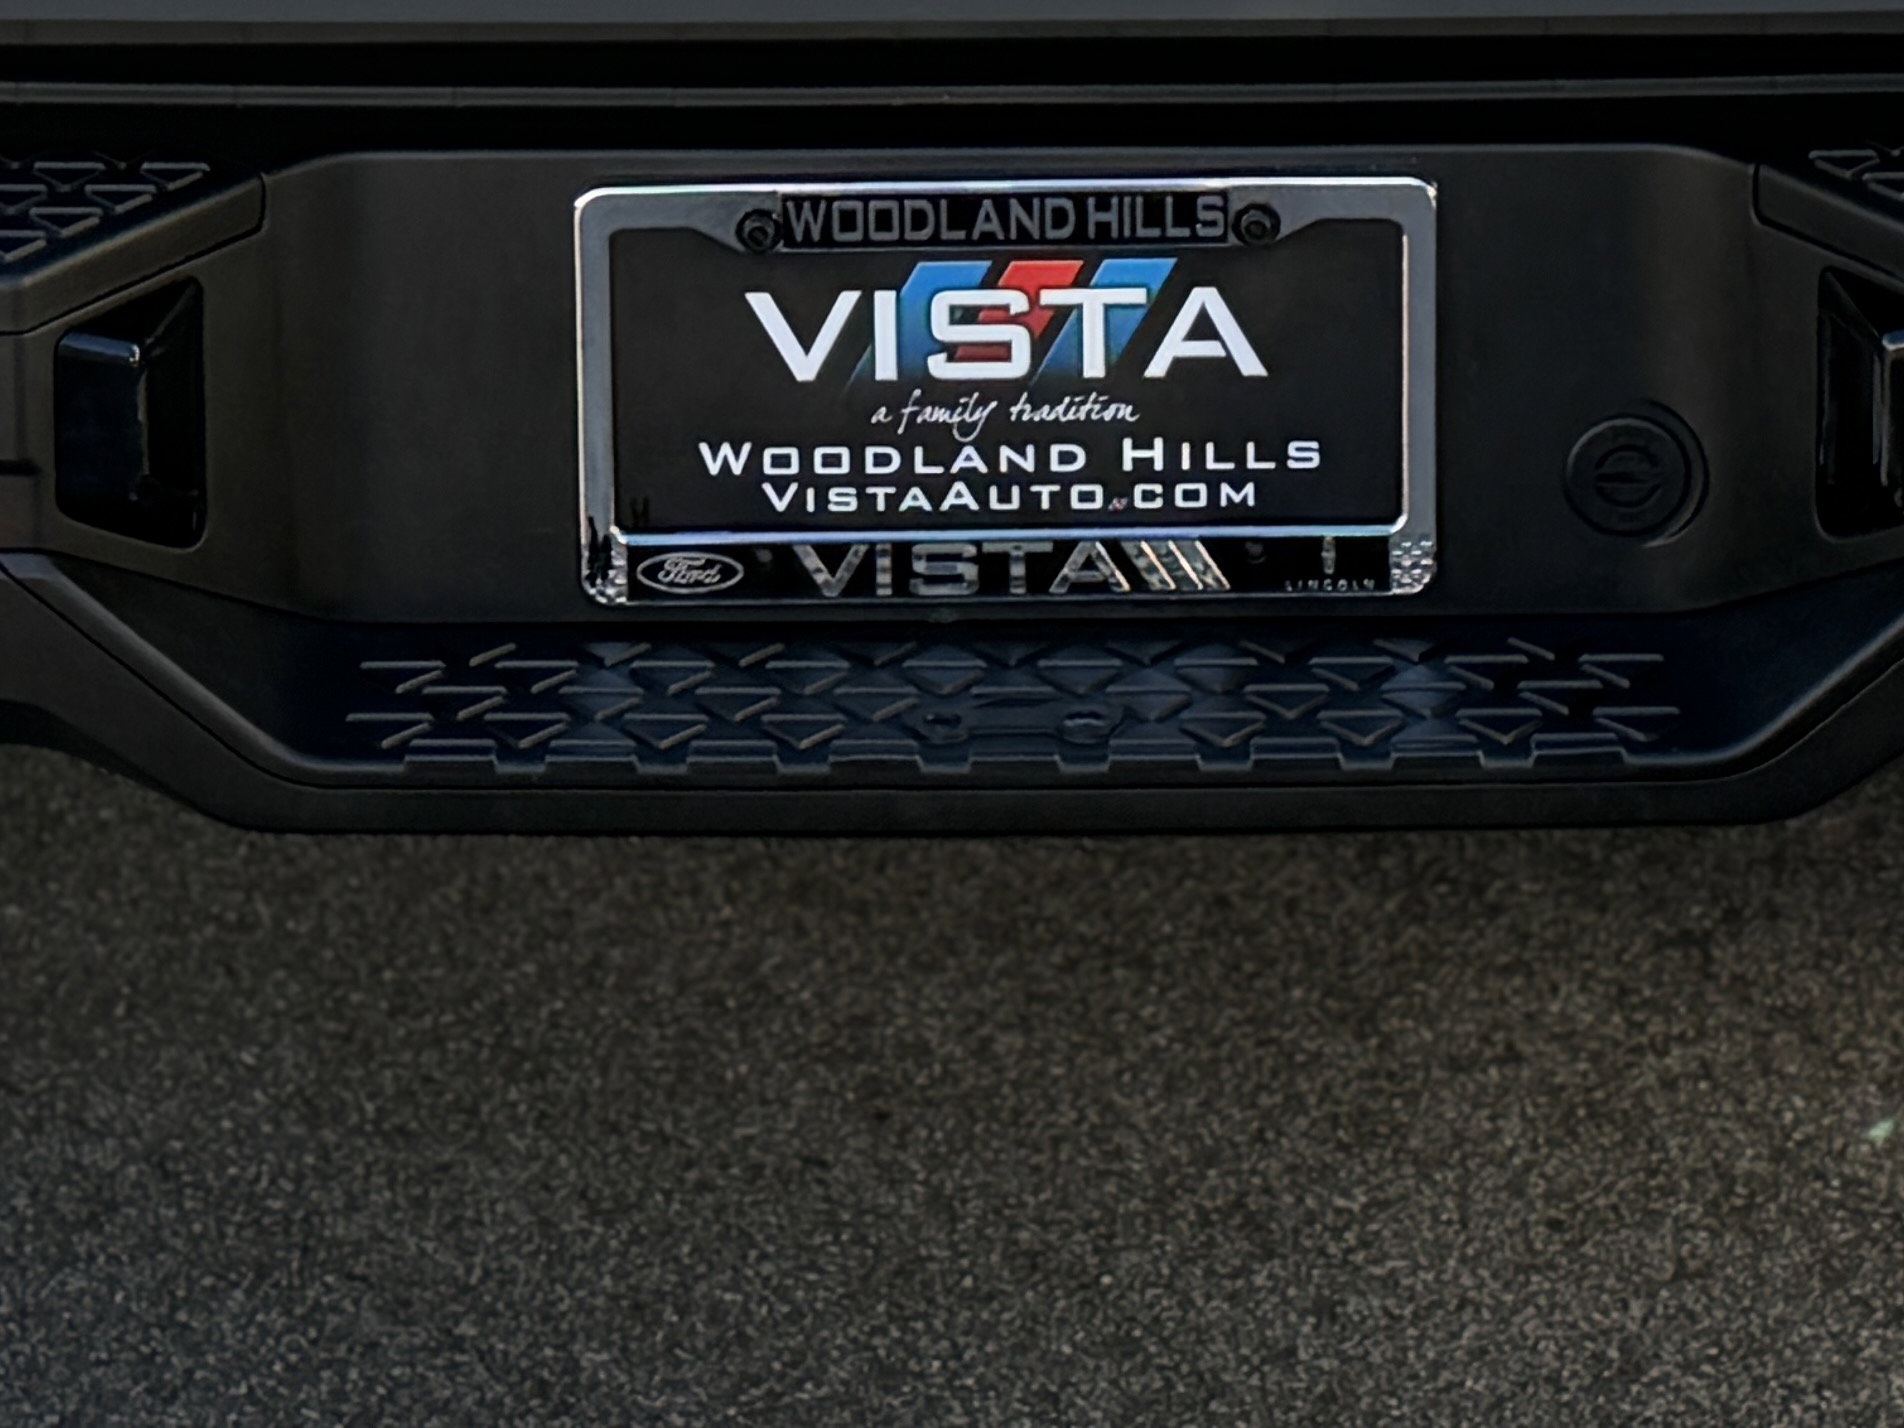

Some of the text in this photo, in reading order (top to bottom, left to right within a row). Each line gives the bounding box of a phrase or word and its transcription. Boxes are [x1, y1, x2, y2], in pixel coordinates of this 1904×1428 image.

[788, 194, 1225, 243] WOODLAND HILLS
[744, 286, 1269, 382] VISTA
[869, 388, 1141, 443] a family tradition
[793, 540, 1132, 598] VISTA
